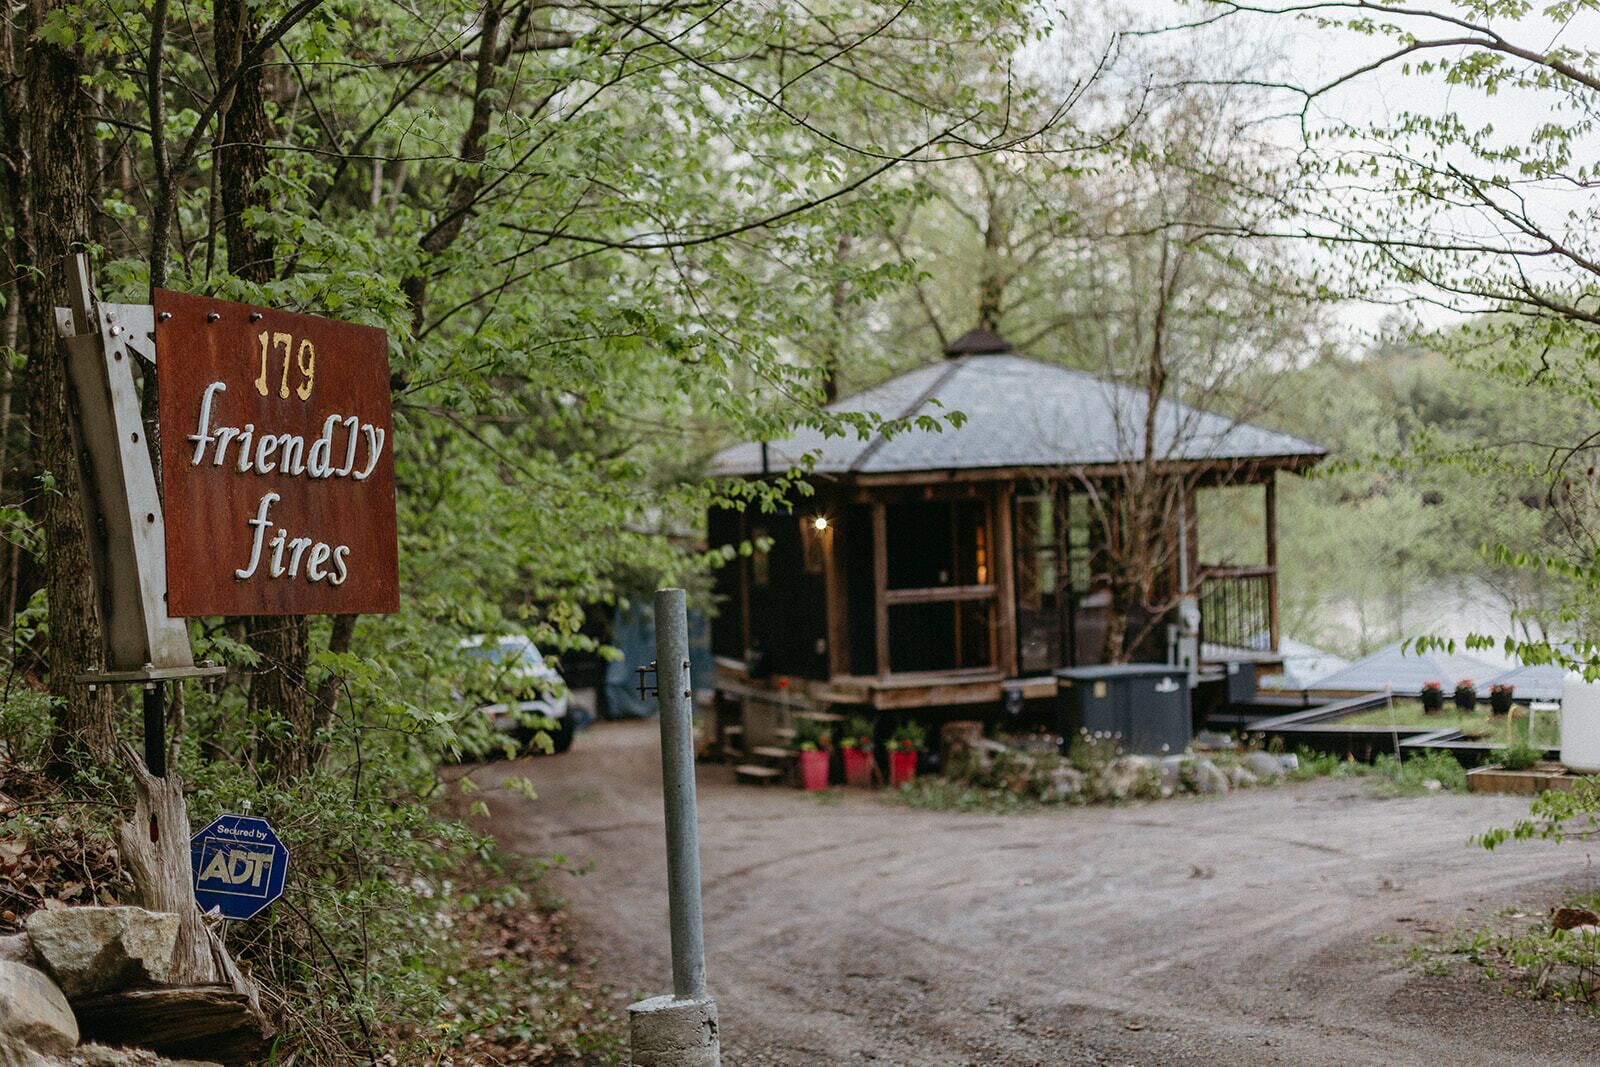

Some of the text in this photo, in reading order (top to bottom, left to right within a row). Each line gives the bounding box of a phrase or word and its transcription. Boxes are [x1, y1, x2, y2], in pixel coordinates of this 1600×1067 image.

[255, 330, 316, 401] 179
[187, 381, 385, 480] friendly
[235, 492, 350, 586] fires
[199, 848, 273, 887] ADT
[217, 824, 267, 840] Secured by
